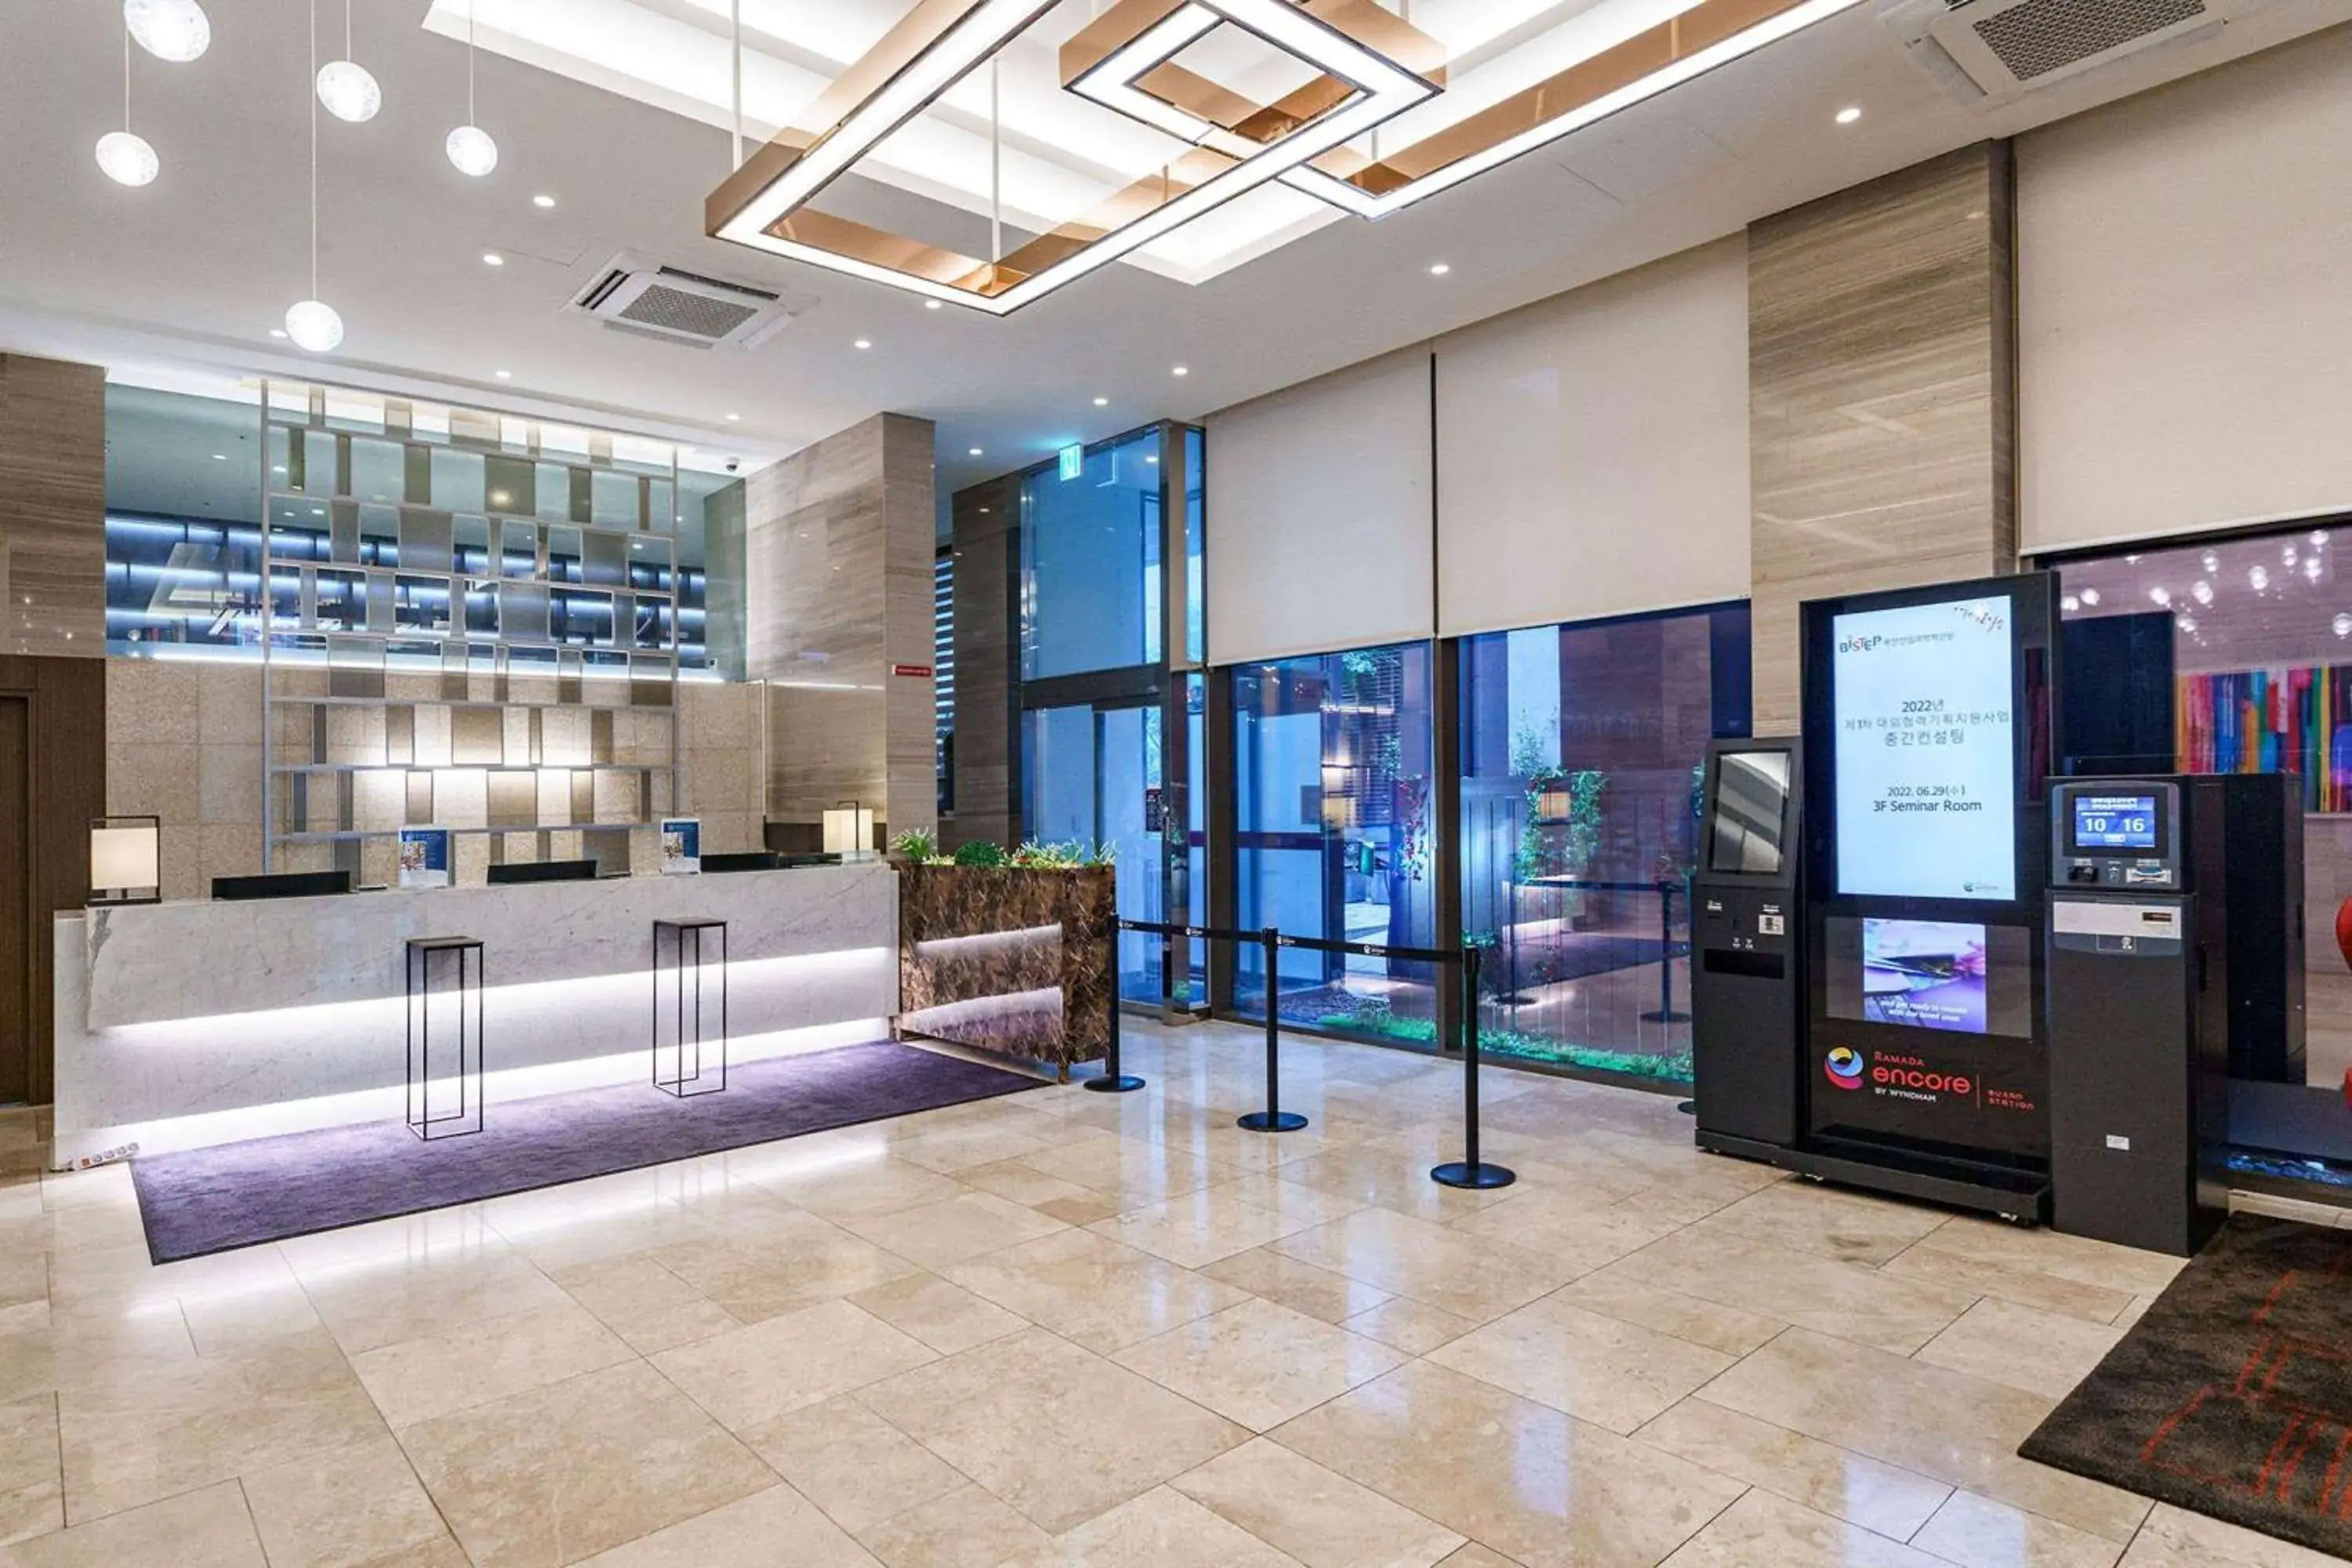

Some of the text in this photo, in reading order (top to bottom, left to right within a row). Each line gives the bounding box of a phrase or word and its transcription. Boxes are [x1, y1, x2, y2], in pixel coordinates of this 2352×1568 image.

[1901, 699, 1944, 713] 2022년
[1873, 798, 1983, 812] 3F Seminar Room
[2085, 818, 2145, 832] 10 16
[1874, 1051, 1925, 1067] RAMADA
[1872, 1066, 1970, 1094] encore
[1889, 1088, 1937, 1103] WYNDHAM
